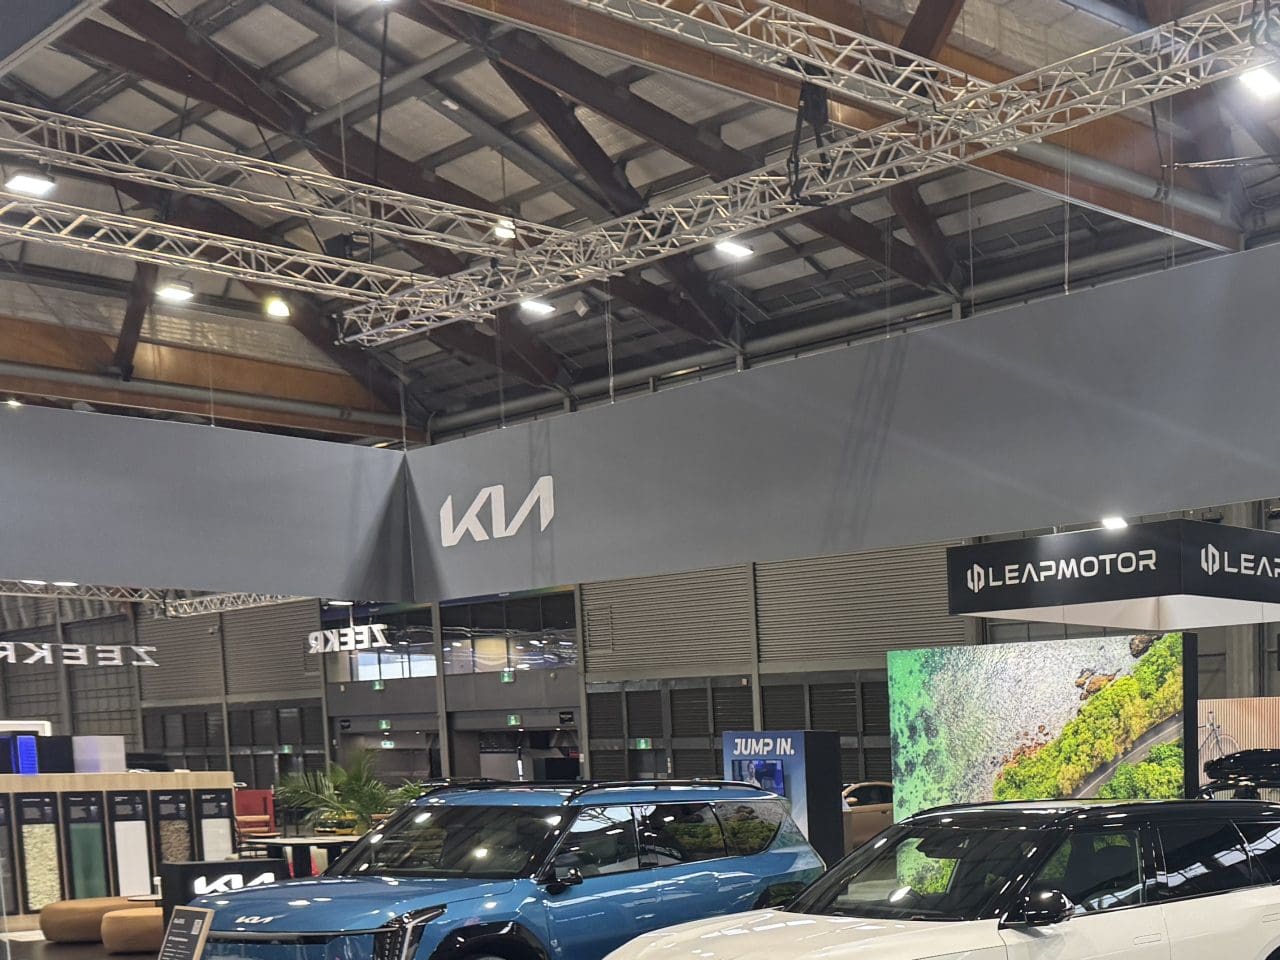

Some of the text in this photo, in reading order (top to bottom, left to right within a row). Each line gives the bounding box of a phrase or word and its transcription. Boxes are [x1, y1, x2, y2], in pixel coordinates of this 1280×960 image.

[440, 475, 555, 547] KIA
[988, 549, 1157, 587] LEAPMOTOR
[733, 738, 796, 756] JUMP IN.
